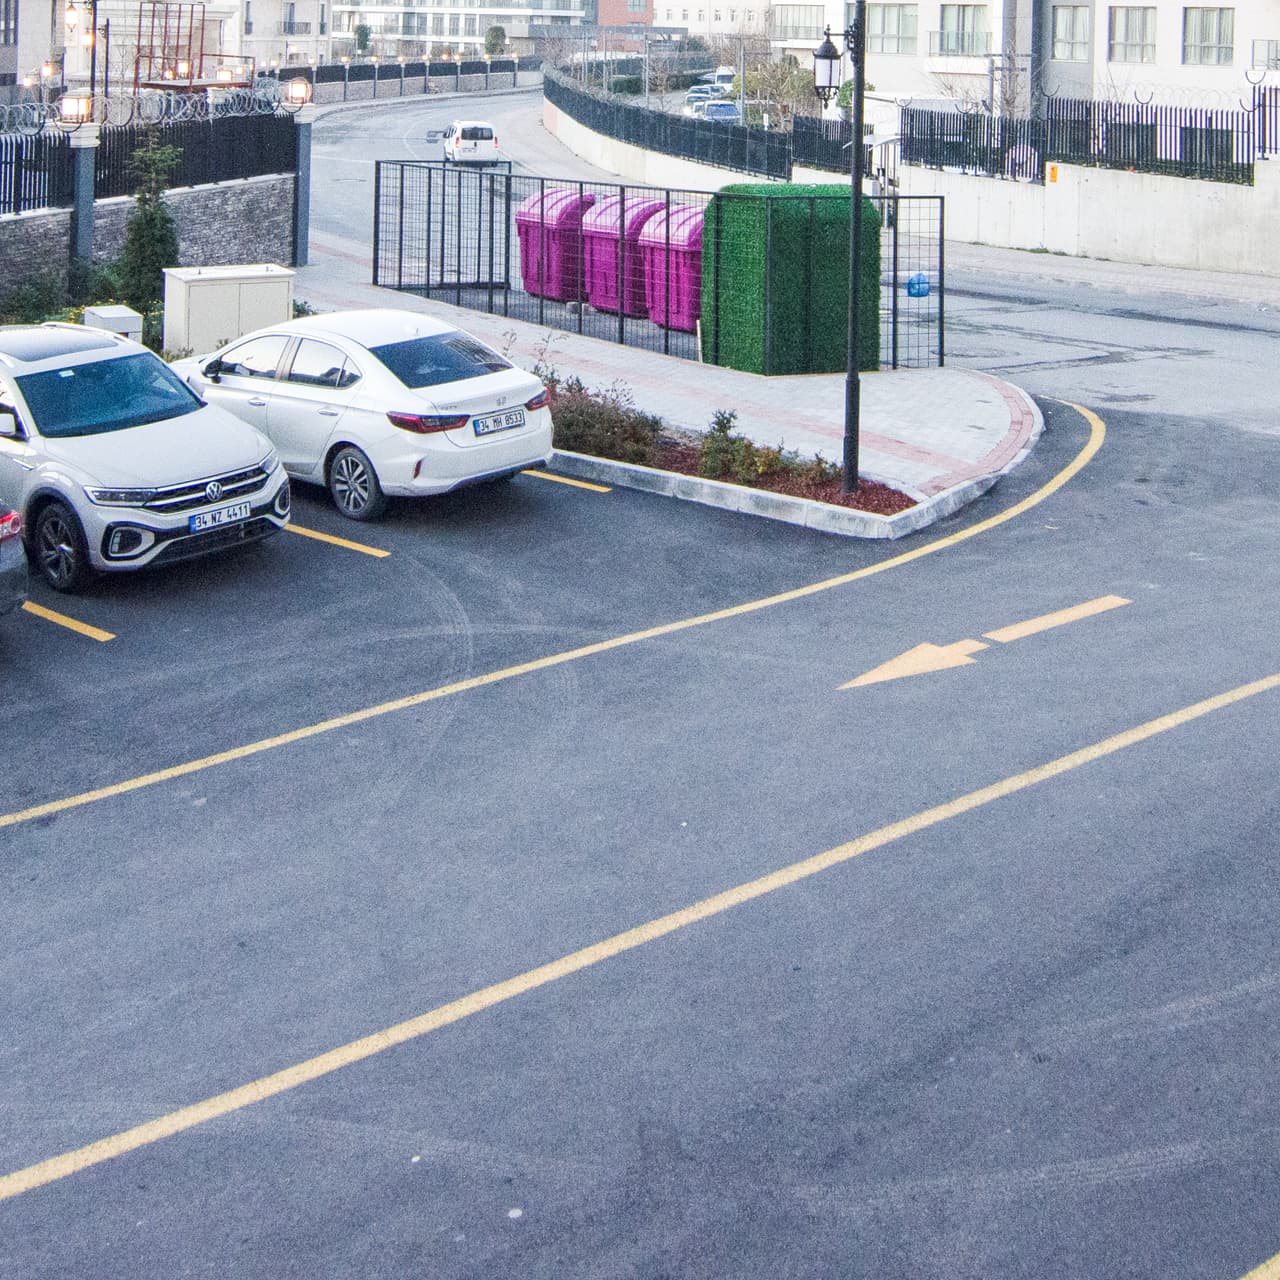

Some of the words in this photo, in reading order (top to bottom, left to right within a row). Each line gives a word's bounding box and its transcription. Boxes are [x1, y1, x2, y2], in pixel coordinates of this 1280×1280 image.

[479, 420, 490, 432] 34
[505, 412, 522, 425] 8533
[195, 515, 208, 528] 34
[226, 504, 248, 520] 4411
